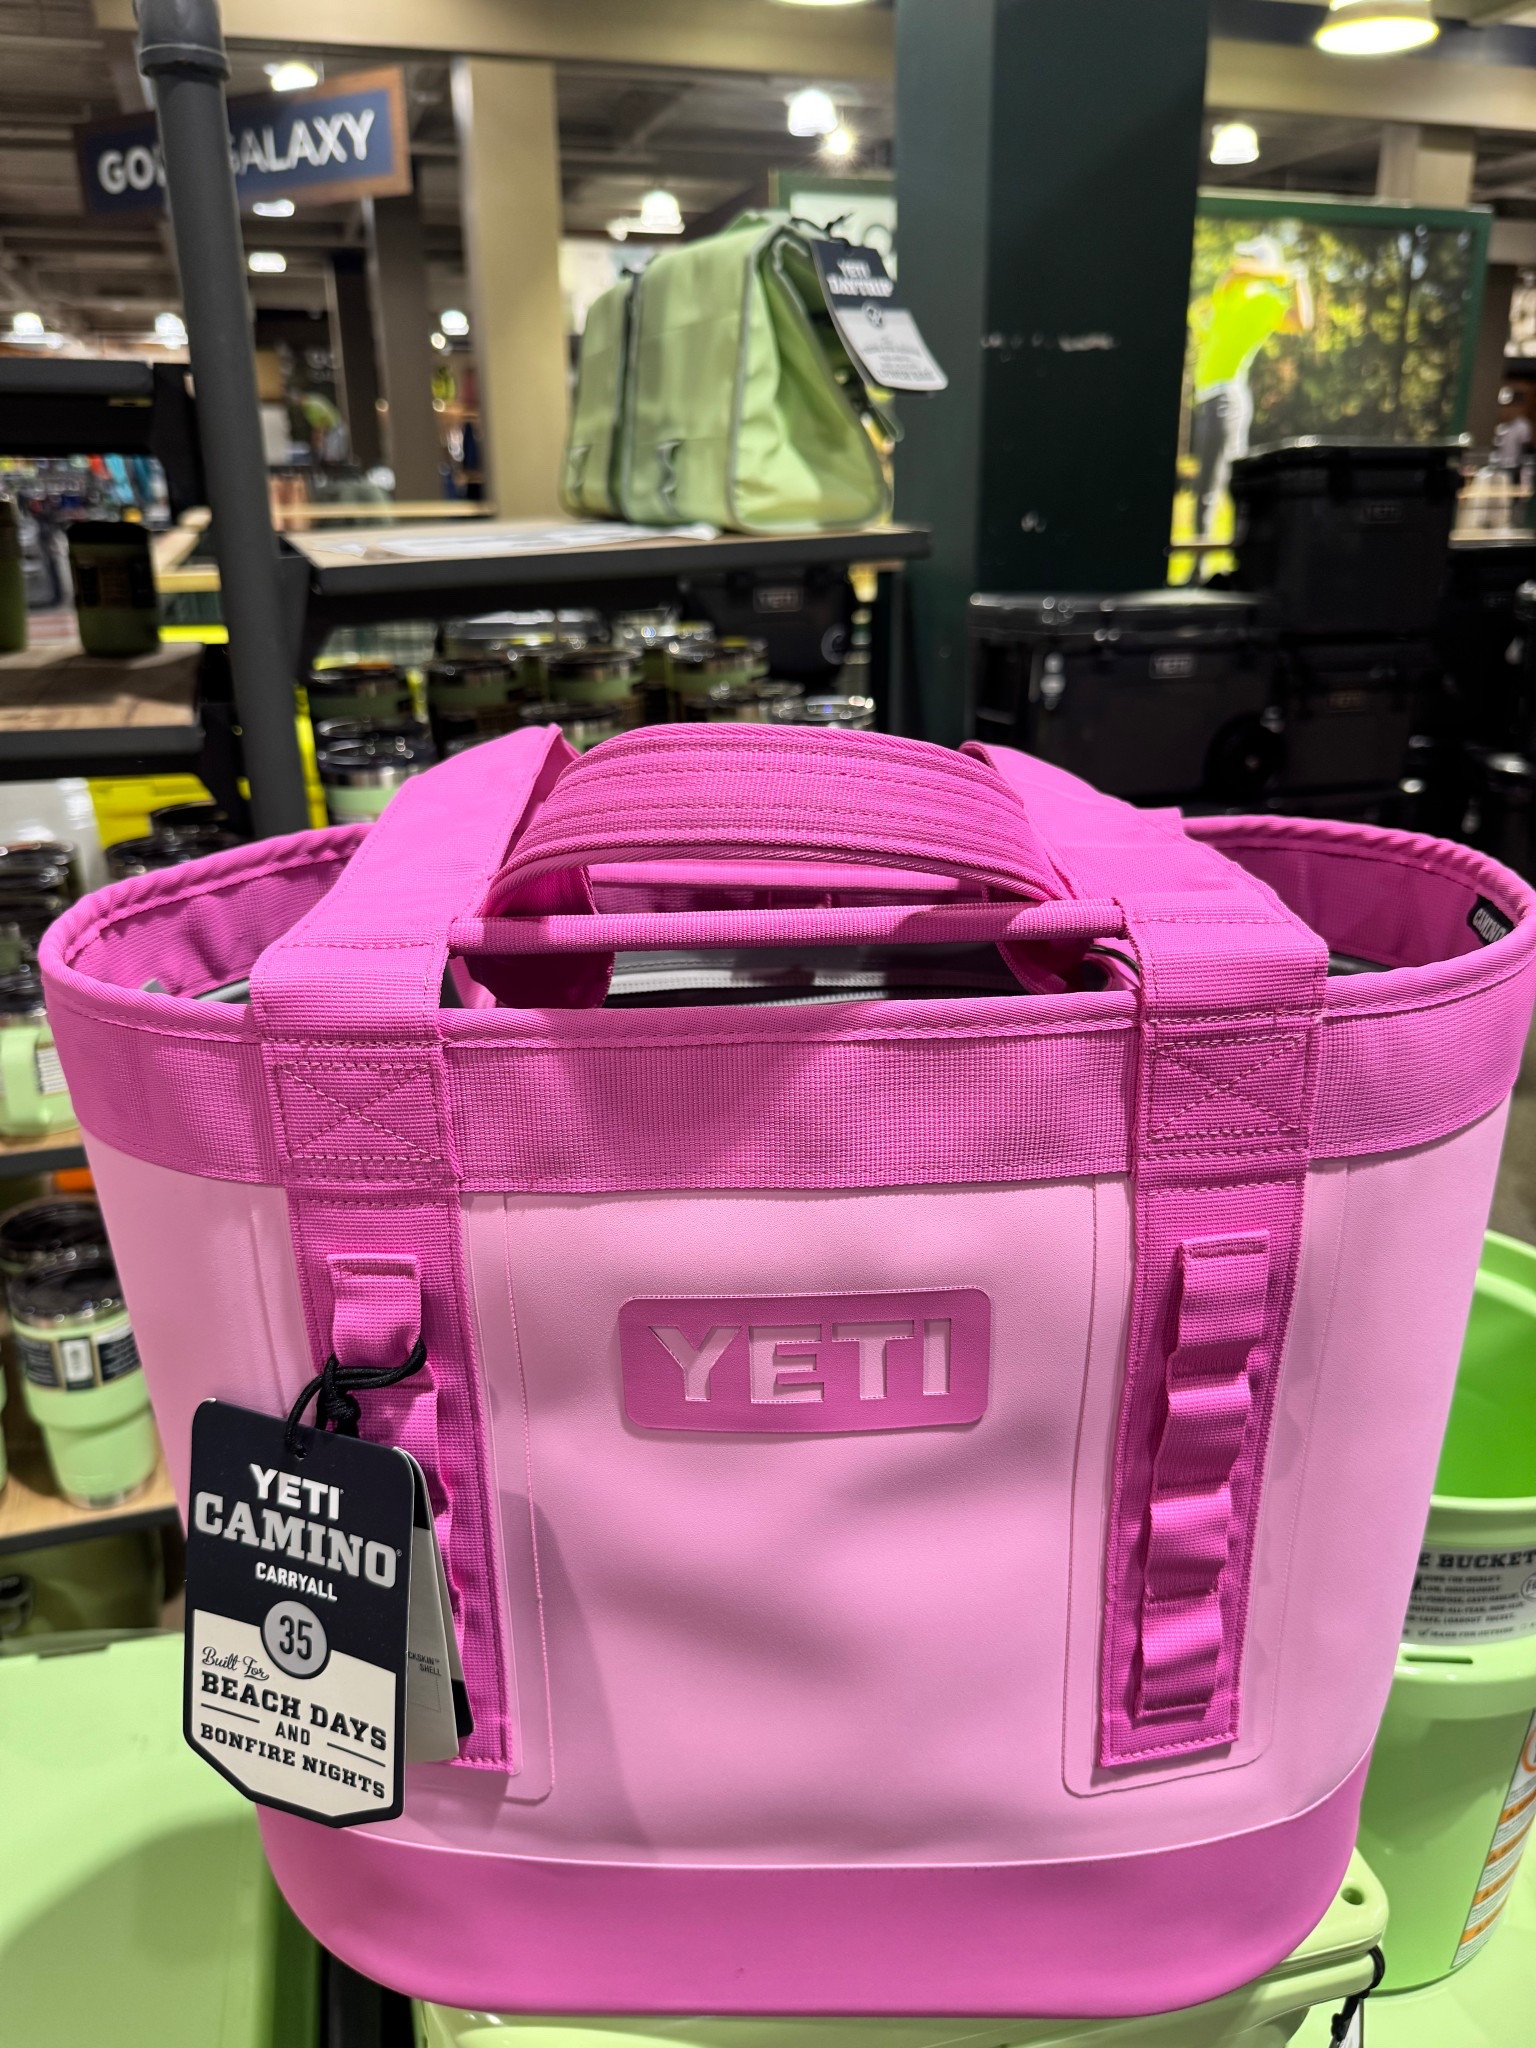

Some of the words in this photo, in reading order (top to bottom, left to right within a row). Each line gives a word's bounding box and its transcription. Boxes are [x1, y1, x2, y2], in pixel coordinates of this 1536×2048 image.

[648, 1317, 952, 1404] YETI
[255, 1561, 338, 1601] CARRYALL
[279, 1615, 313, 1660] 35
[202, 1646, 241, 1671] Built
[243, 1655, 269, 1681] For
[419, 1664, 442, 1677] SHELL
[201, 1670, 301, 1720] BEACH
[310, 1702, 387, 1751] DAYS
[275, 1720, 311, 1746] AND
[200, 1722, 295, 1767] BONFIRE
[302, 1754, 385, 1799] NIGHTS
